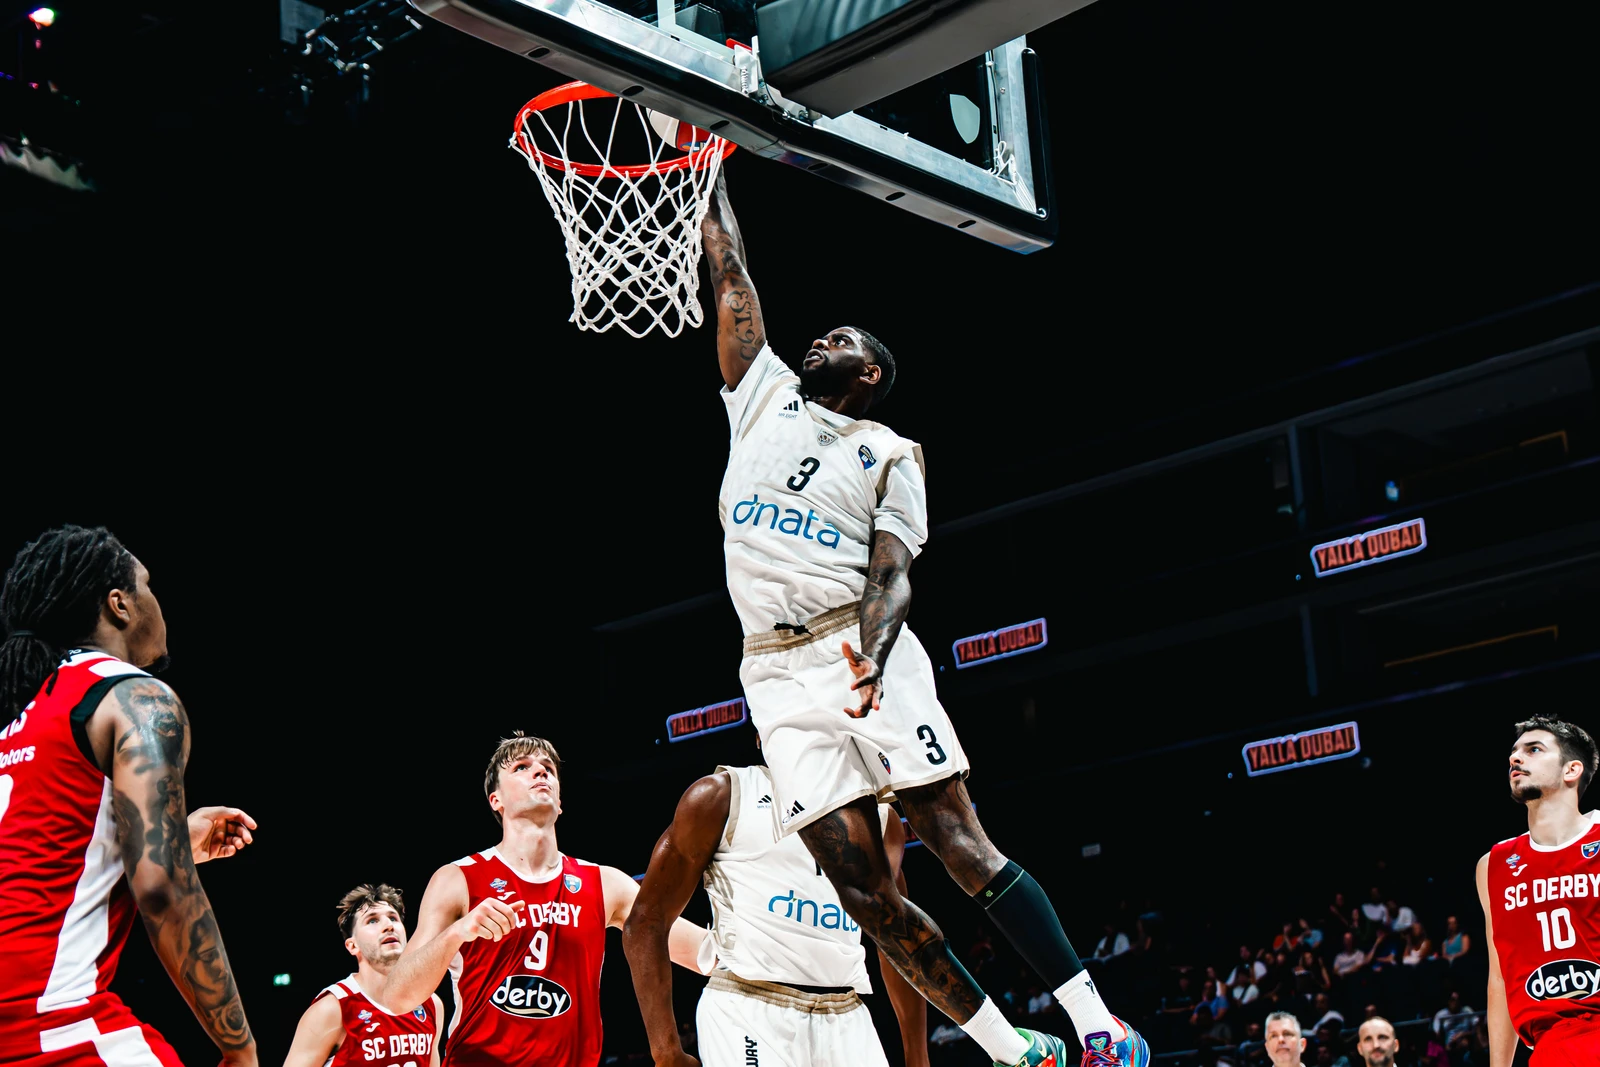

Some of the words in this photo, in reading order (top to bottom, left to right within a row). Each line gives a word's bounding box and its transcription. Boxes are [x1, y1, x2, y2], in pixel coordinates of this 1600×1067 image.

[786, 457, 820, 492] 3
[733, 494, 841, 549] dnata
[1317, 539, 1365, 570] YALLA
[957, 635, 997, 662] YALLA
[670, 712, 703, 736] YALLA
[0, 745, 36, 769] otors
[916, 724, 947, 765] 3
[1248, 739, 1297, 769] YALLA
[1504, 882, 1528, 911] SC
[1532, 873, 1600, 904] DERBY
[528, 901, 582, 928] DERBY
[1536, 907, 1576, 952] 10
[524, 930, 549, 971] 9
[492, 976, 567, 1016] derby
[1531, 965, 1600, 998] derby
[361, 1037, 386, 1061] SC
[389, 1033, 433, 1058] DERBY
